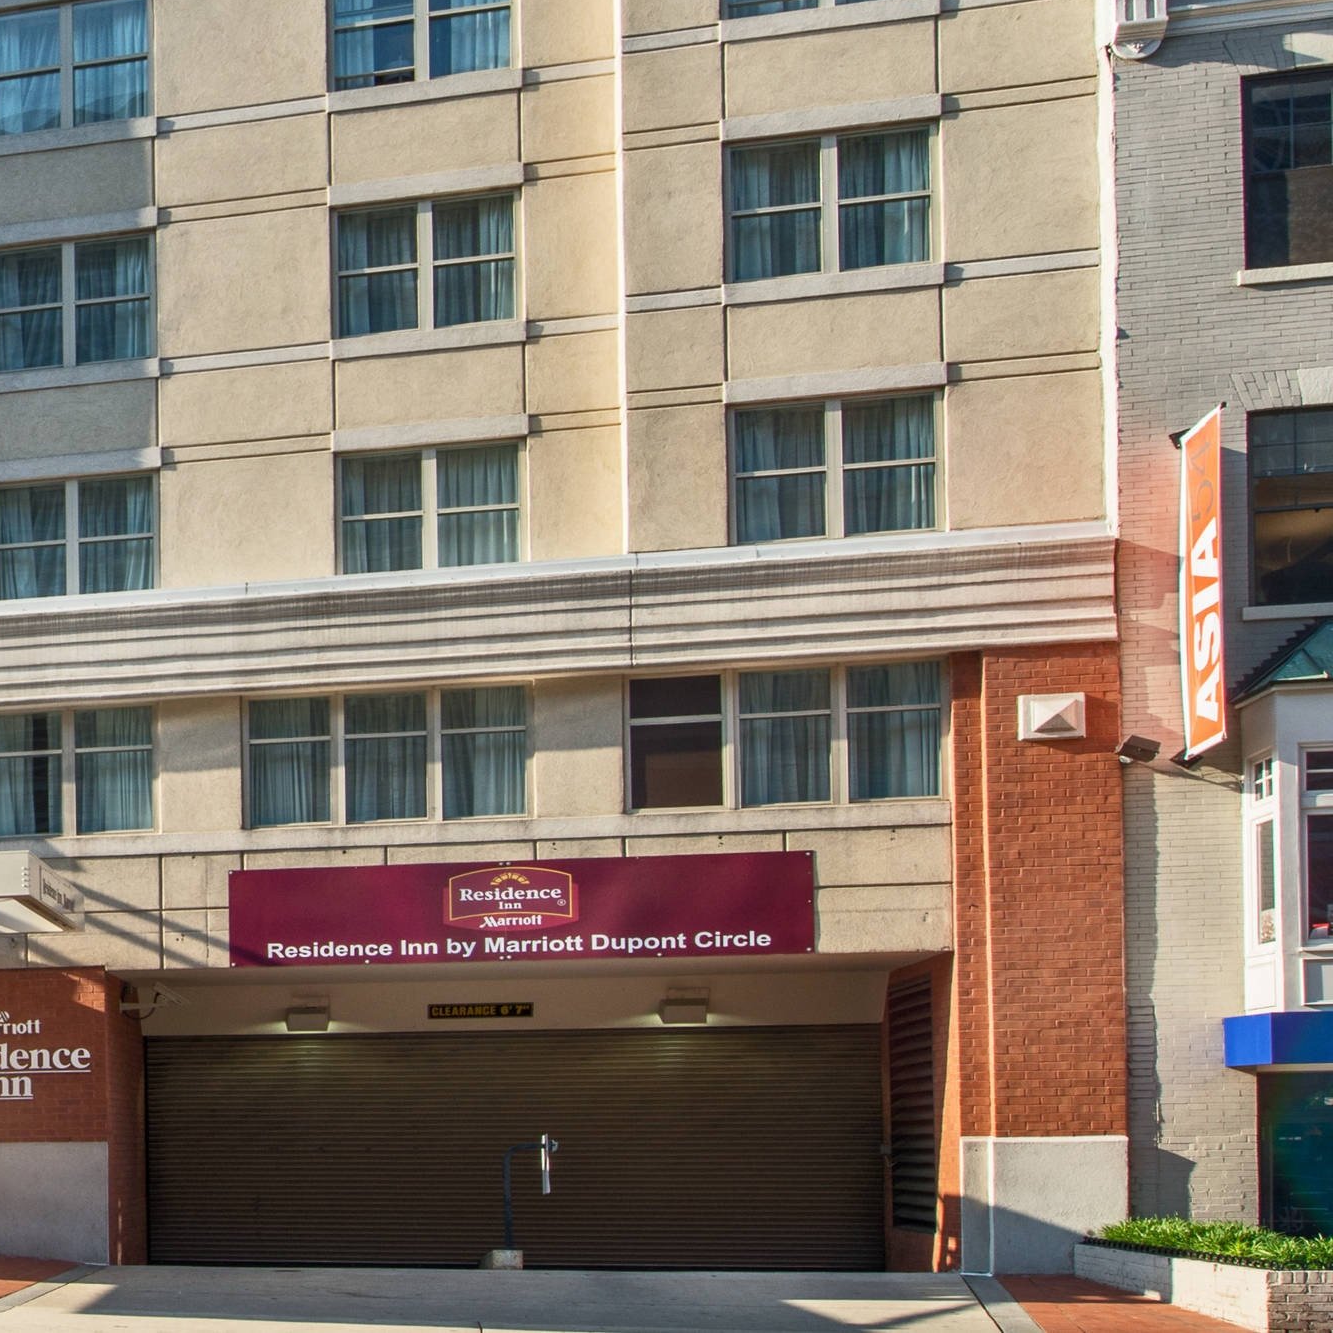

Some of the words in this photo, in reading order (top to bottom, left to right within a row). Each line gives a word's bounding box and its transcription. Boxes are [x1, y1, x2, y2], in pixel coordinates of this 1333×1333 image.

[1190, 517, 1220, 723] ASIA
[459, 887, 562, 901] Residence
[498, 901, 522, 910] Inn
[479, 915, 542, 928] Marriott
[267, 941, 393, 959] Residence
[400, 939, 438, 956] Inn
[446, 938, 476, 958] by
[484, 935, 583, 954] Marriott
[591, 932, 687, 953] Dupont
[694, 930, 772, 949] Circle
[431, 1005, 497, 1017] CLEARANCE
